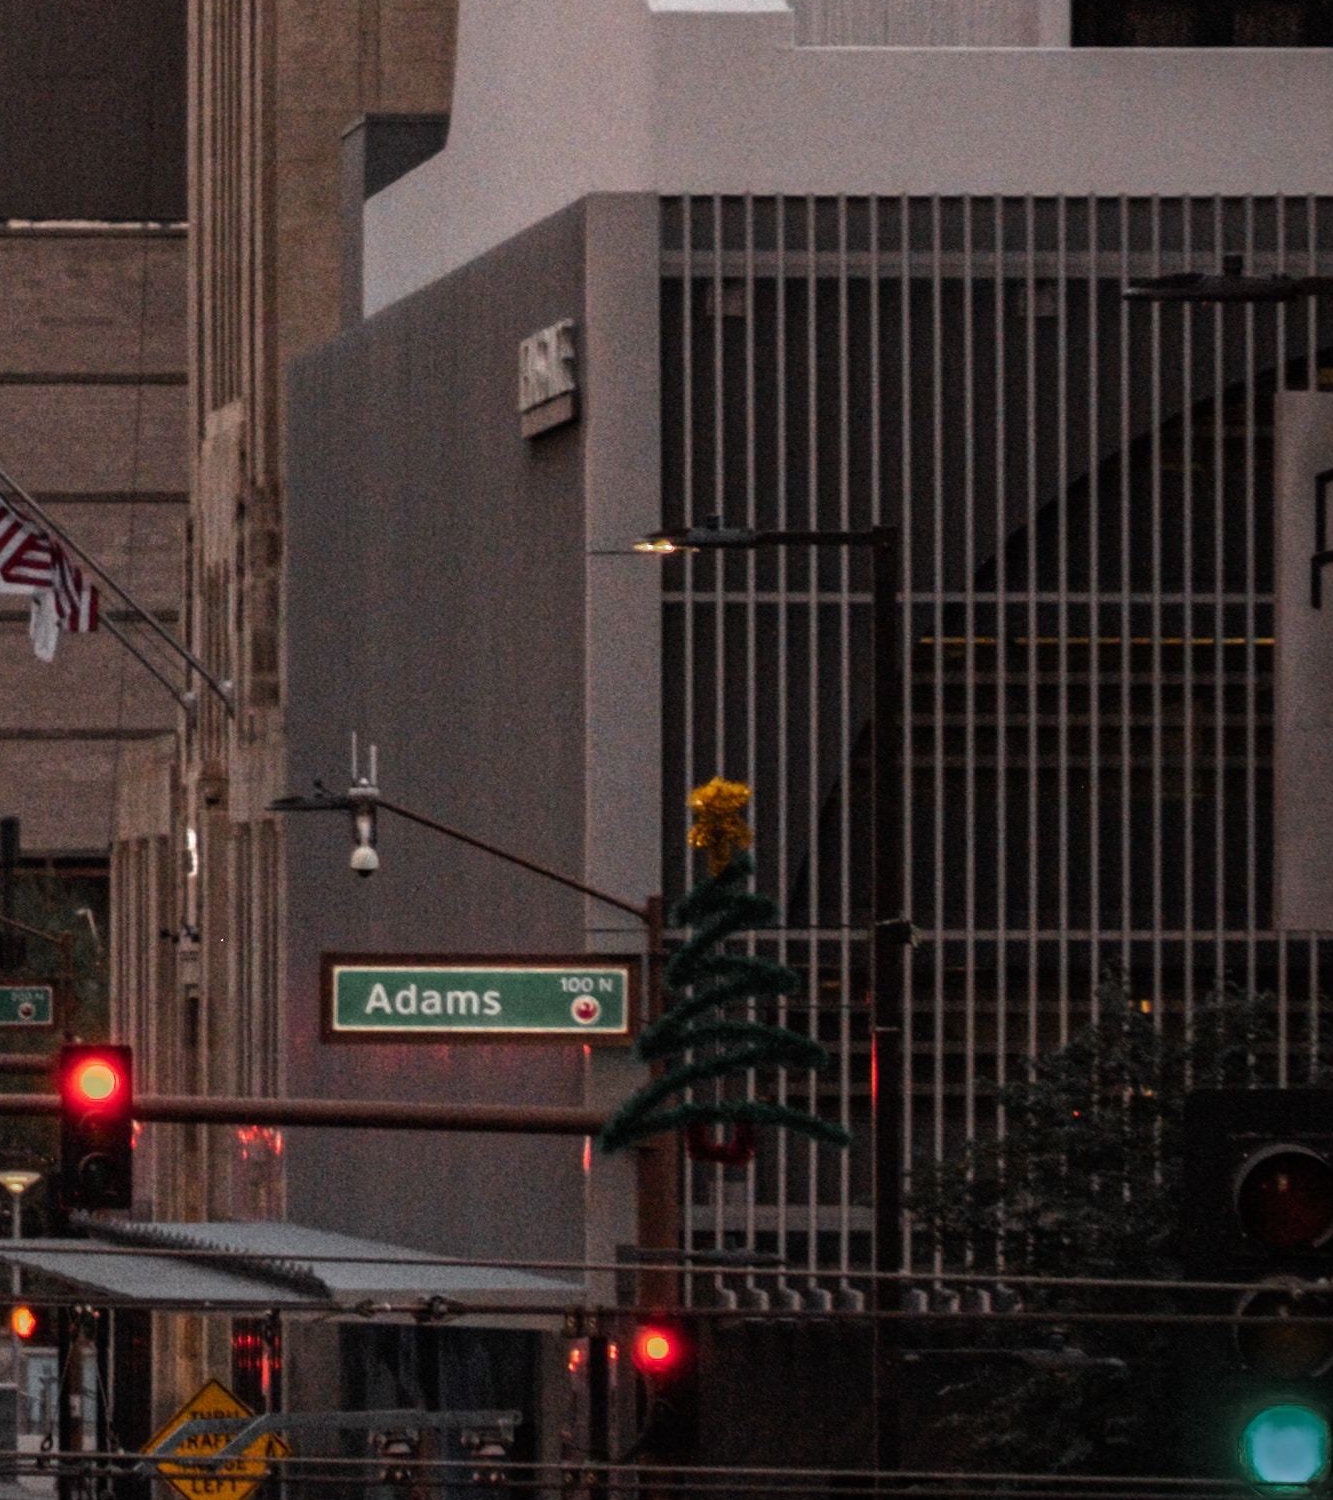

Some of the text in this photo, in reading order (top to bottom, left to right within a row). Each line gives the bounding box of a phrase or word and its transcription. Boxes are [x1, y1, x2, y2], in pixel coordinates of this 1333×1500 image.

[560, 977, 613, 993] 100 N
[364, 982, 502, 1016] Adams
[191, 1476, 237, 1494] LEFT
